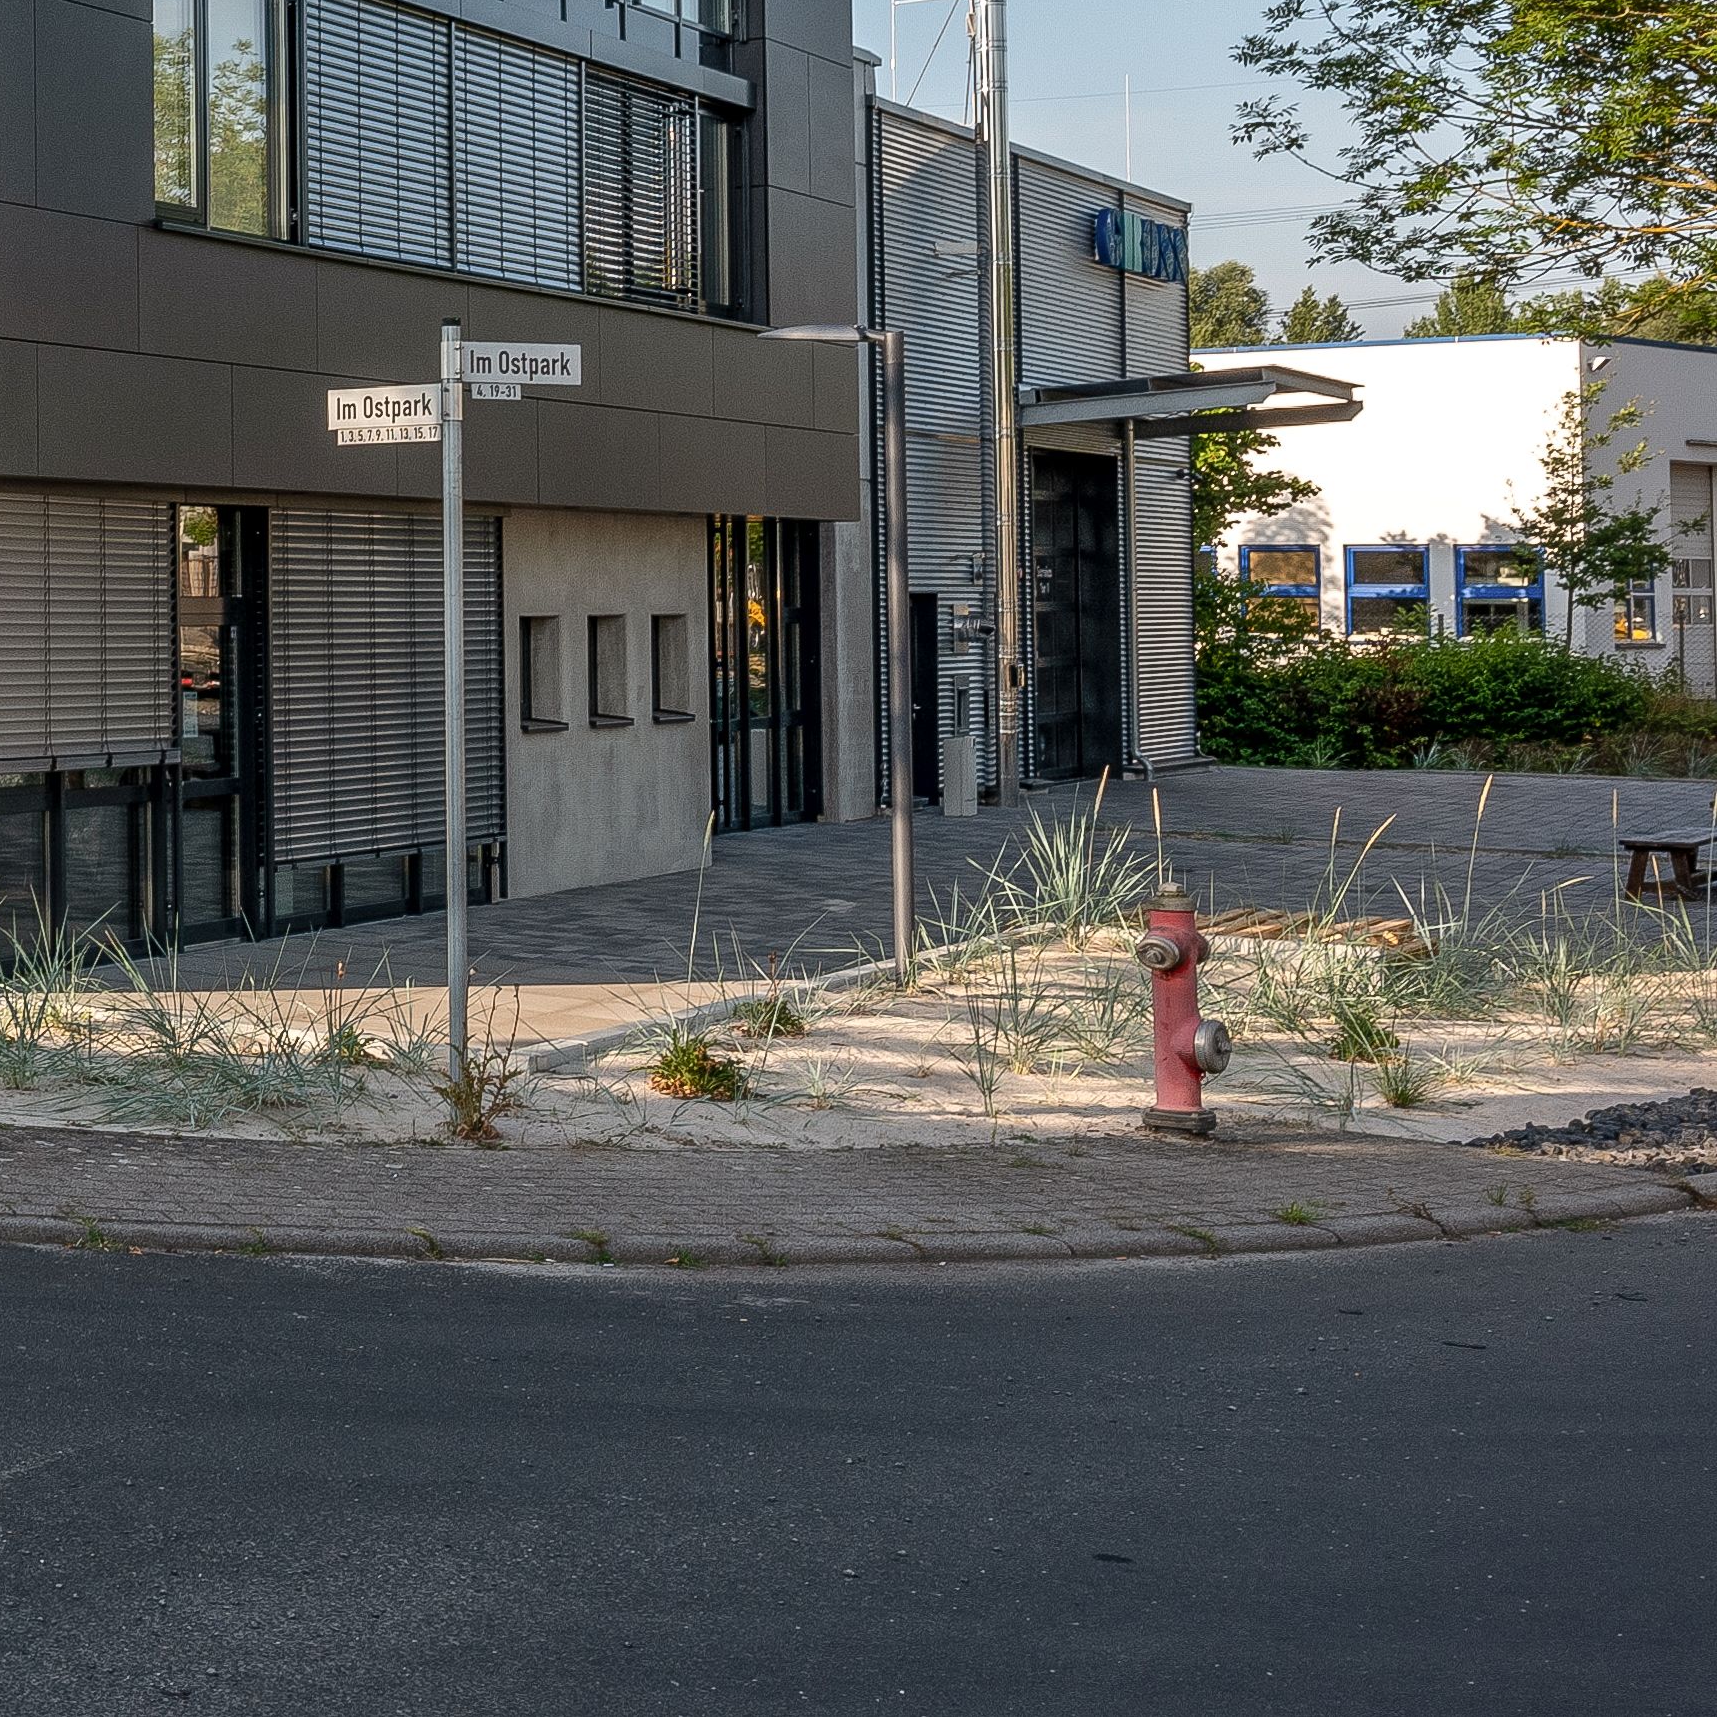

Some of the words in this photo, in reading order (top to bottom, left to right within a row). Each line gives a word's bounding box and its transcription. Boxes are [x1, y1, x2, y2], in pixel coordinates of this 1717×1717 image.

[470, 350, 492, 374] Im
[498, 350, 571, 381] Ostpark
[490, 384, 516, 397] 19-31
[337, 397, 357, 420] Im
[363, 393, 432, 423] Ostpark
